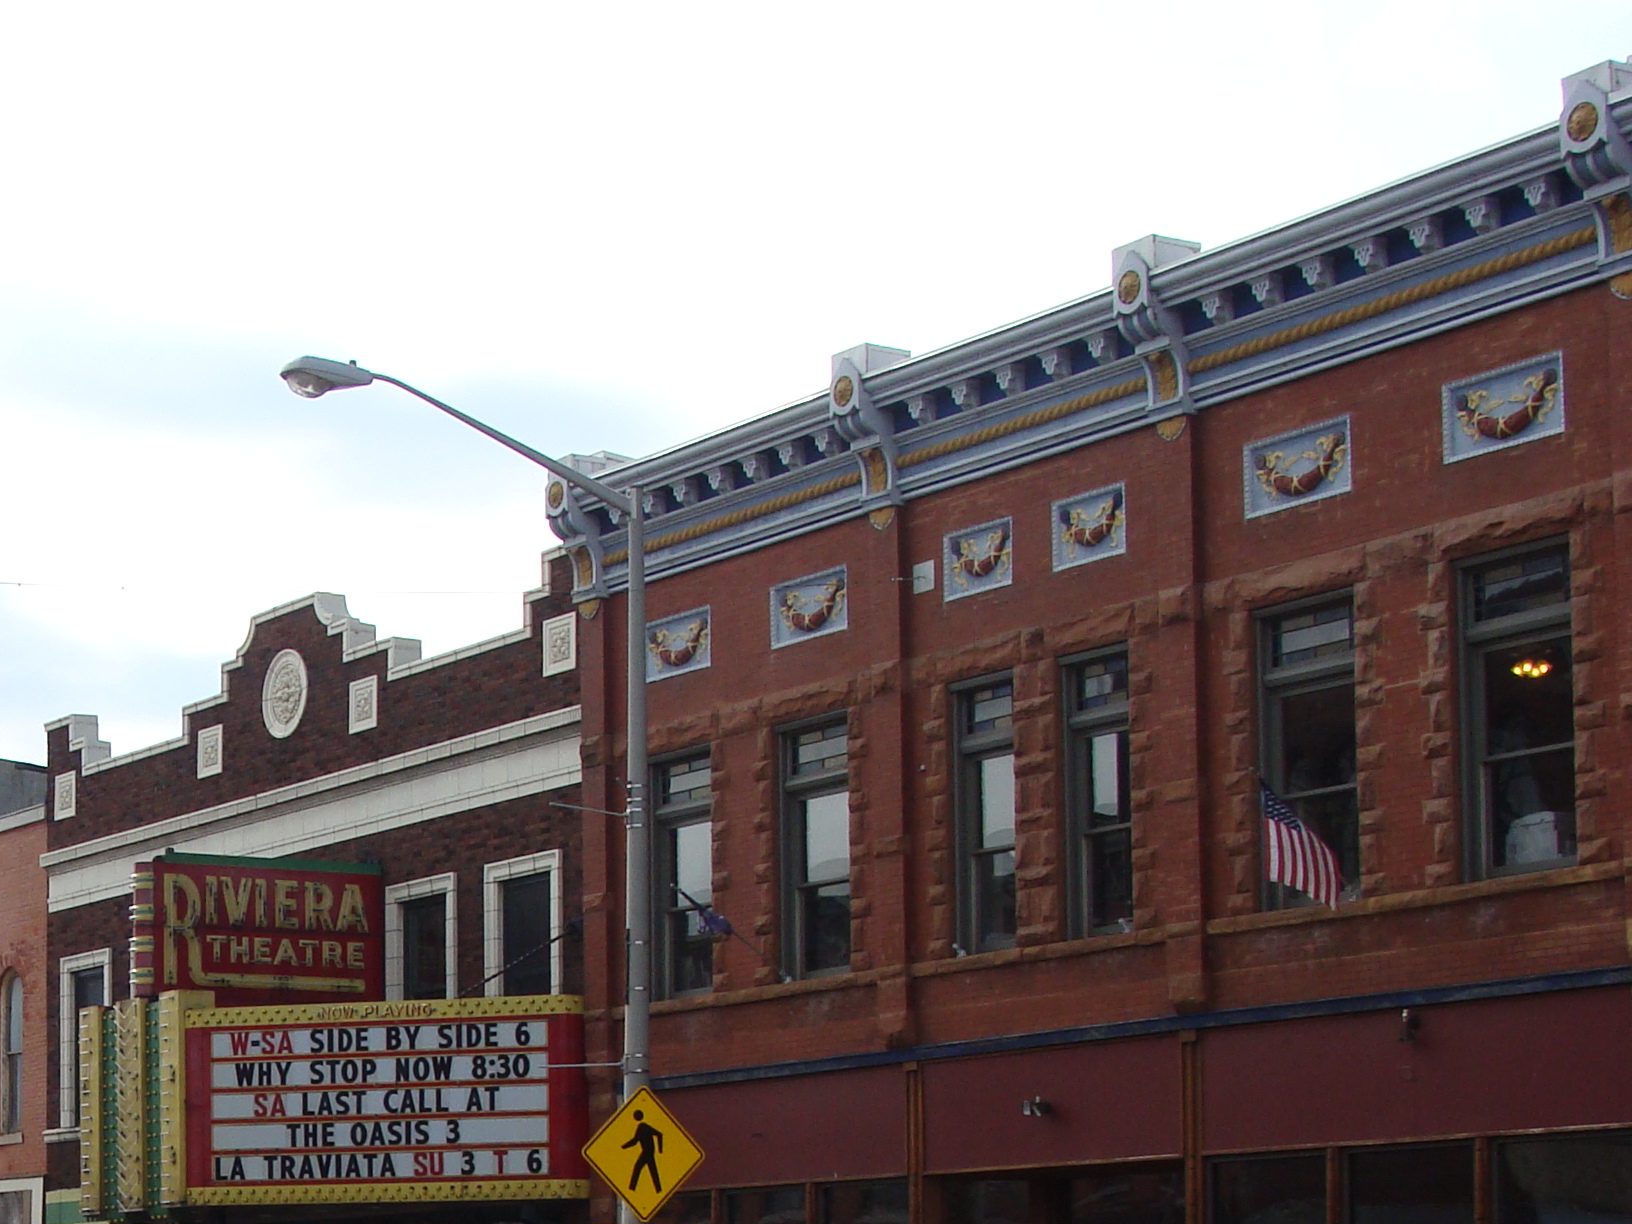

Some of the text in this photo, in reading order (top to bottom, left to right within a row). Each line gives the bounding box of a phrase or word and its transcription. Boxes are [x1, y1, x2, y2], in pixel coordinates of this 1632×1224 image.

[163, 872, 369, 984] RIVIERA
[206, 934, 366, 969] THEATRE
[320, 1002, 433, 1020] NOW PLAYING
[230, 1021, 531, 1056] W-SA SIDE BY SIDE 6
[235, 1053, 530, 1087] WHY STOP NOW 8:30
[253, 1085, 500, 1117] SA LAST CALL AT
[286, 1119, 461, 1148] THE OASIS 3
[214, 1149, 542, 1181] LA TRAVIATA SU 3 T 6
